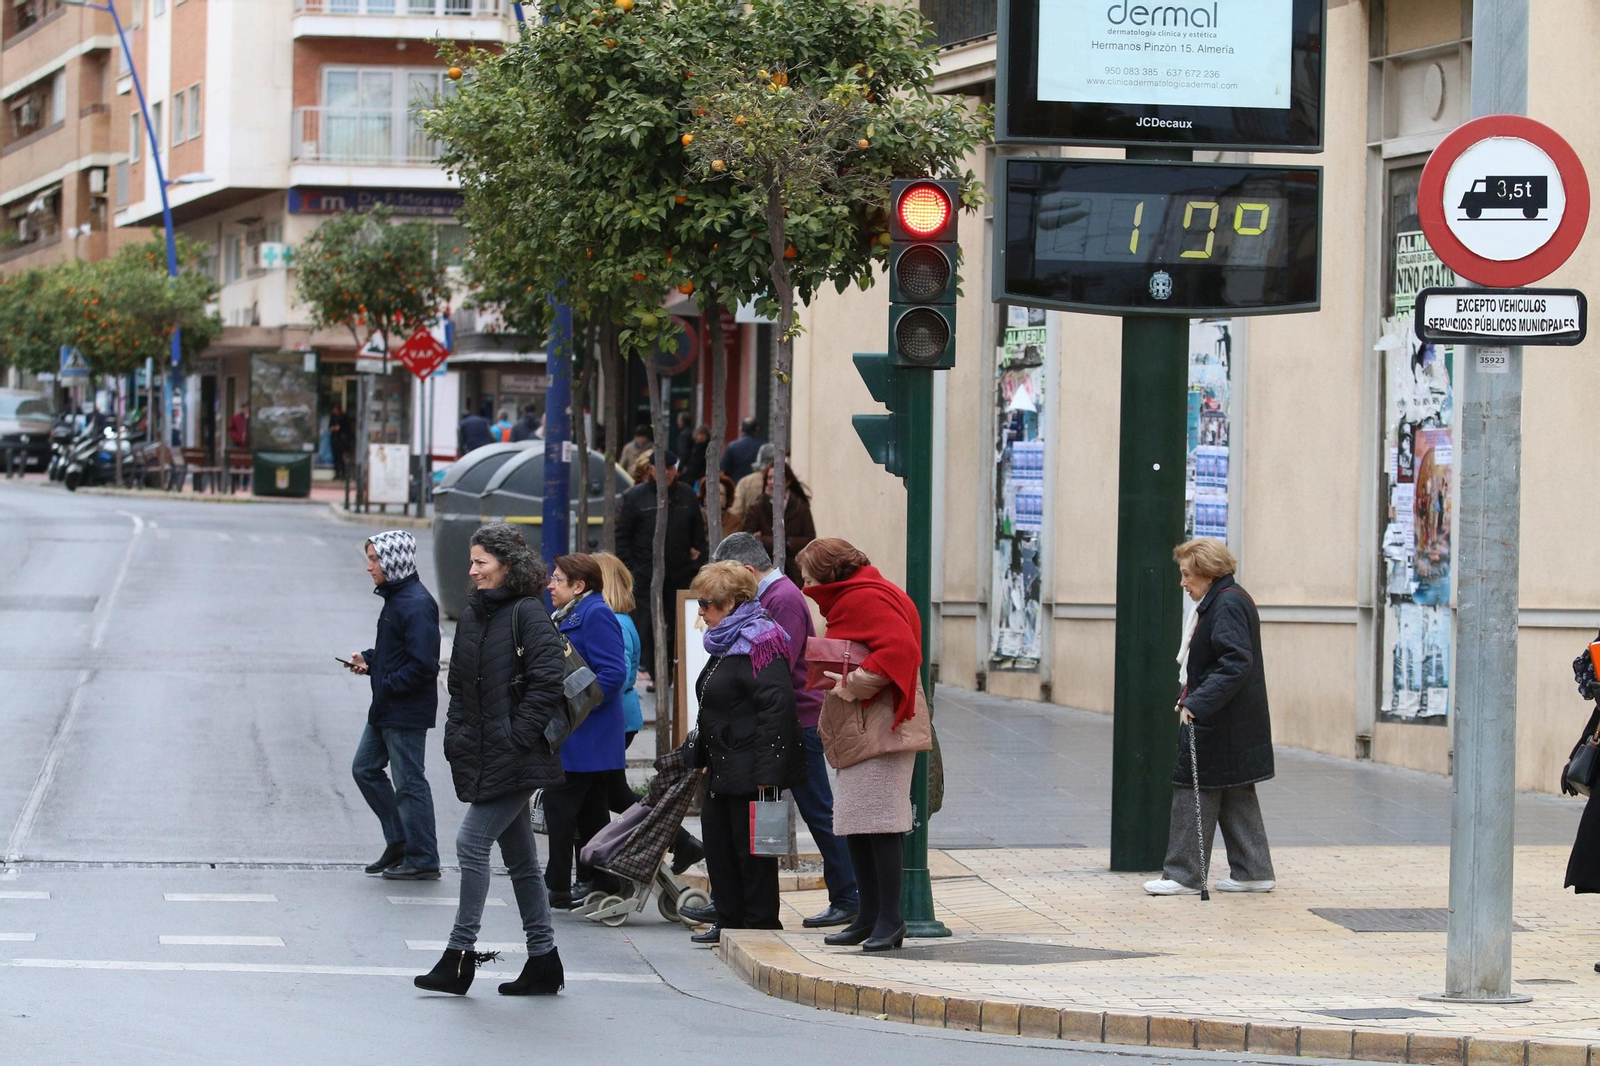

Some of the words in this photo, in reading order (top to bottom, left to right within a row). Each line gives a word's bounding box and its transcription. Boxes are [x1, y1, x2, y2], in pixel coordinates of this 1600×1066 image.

[1107, 0, 1218, 28] dermal
[1091, 40, 1141, 52] Hermanos
[1144, 42, 1177, 53] Pinzón
[1196, 44, 1234, 55] Almería
[1104, 66, 1121, 75] 950
[1123, 67, 1140, 76] 083
[1142, 68, 1159, 77] 385
[1166, 69, 1183, 78] 637
[1185, 69, 1201, 78] 672
[1203, 70, 1220, 79] 236
[1135, 117, 1193, 129] JCDecaux
[1456, 298, 1497, 313] EXCEPTO
[1428, 318, 1473, 331] SERVICIOS
[1475, 315, 1517, 332] PÚBLICOS
[1479, 356, 1506, 364] 35923
